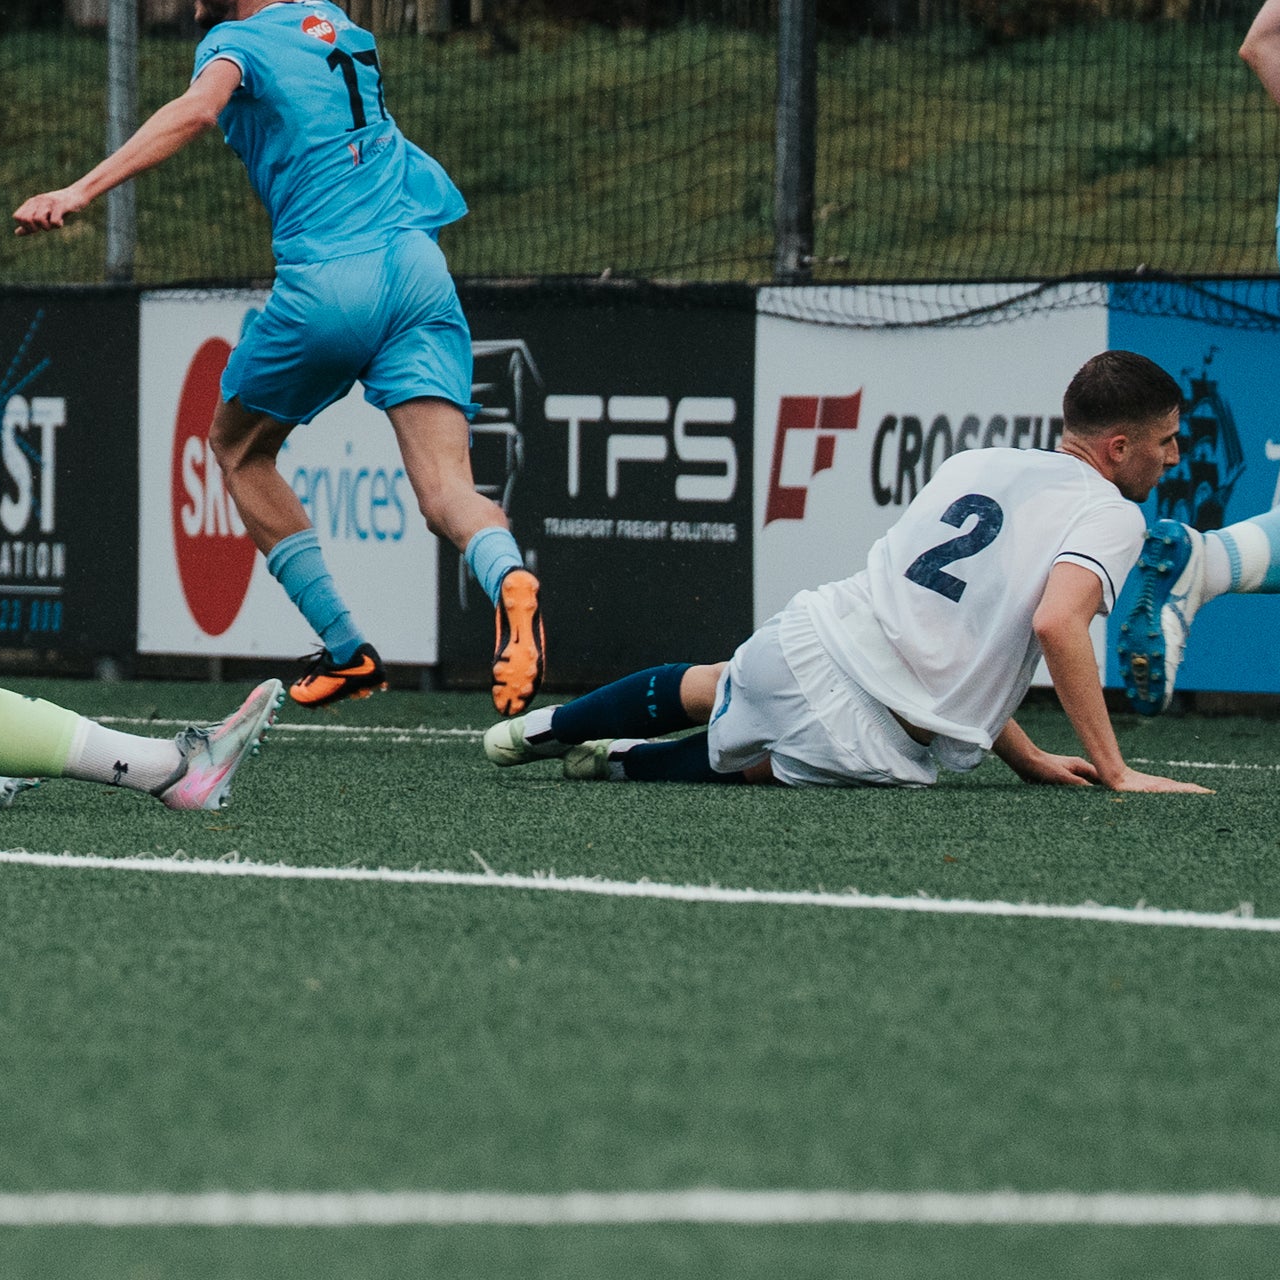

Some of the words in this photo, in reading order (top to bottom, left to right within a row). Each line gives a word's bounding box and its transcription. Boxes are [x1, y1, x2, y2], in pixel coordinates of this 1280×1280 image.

[283, 440, 407, 542] ervices
[543, 394, 738, 503] TFS
[544, 517, 614, 538] TRANSPORT
[616, 519, 668, 540] FREIGHT
[671, 521, 738, 542] SOLUTIONS
[904, 493, 1004, 603] 2
